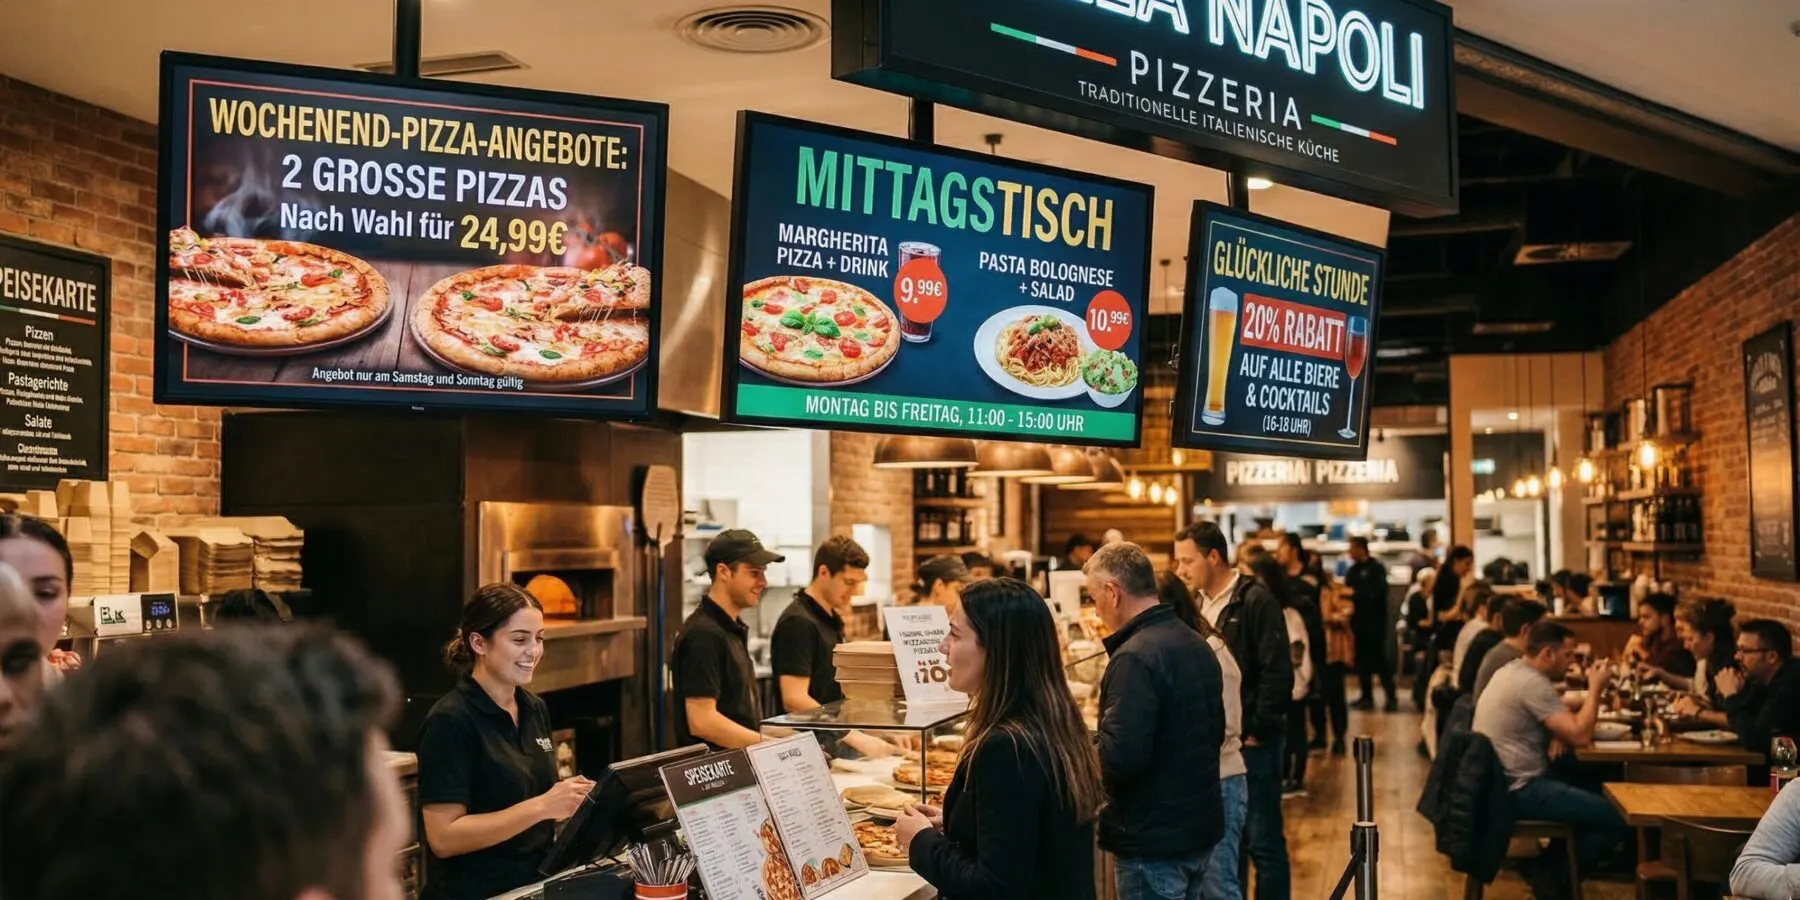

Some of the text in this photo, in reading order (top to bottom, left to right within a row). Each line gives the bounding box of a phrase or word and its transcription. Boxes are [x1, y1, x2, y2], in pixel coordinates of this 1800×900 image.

[1130, 50, 1302, 130] PIZZERIA
[1077, 79, 1199, 126] TRADITIONELLE
[1202, 114, 1293, 152] ITALIENISCHE
[209, 97, 629, 170] WOCHENEND-PIZZA-ANGEBOTE:
[281, 154, 568, 211] 2 GROSSE PIZZAS
[796, 145, 1114, 252] MITTAGSTISCH
[280, 202, 569, 257] Nach Wahl für 24,99€
[778, 223, 889, 257] MARGHERITA
[776, 246, 889, 279] PIZZA + DRINK
[979, 252, 1114, 287] PASTA BOLOGNESE
[1214, 237, 1369, 305] GLÜCKLICHE STUNDE
[1018, 281, 1075, 302] + SALAD
[25, 325, 54, 341] Pizzen
[1243, 302, 1344, 353] 20% RABATT
[8, 372, 69, 392] Pastagerichte
[312, 366, 524, 390] Angebot nur am Samstag und Sonntag gültig
[1240, 353, 1341, 389] AUF ALLE BIERE
[805, 395, 870, 418] MONTAG
[873, 400, 898, 419] BIS
[901, 402, 963, 426] FREITAG,
[967, 407, 1006, 427] 11:00
[1017, 412, 1054, 429] 15:00
[1056, 415, 1084, 432] UHR
[1245, 383, 1331, 416] & COCKTAILS
[25, 414, 52, 429] Salate
[1262, 415, 1312, 438] (16-18 UHR)
[1316, 458, 1399, 483] PIZZERIA
[684, 760, 735, 786] SPEISEKARTE
